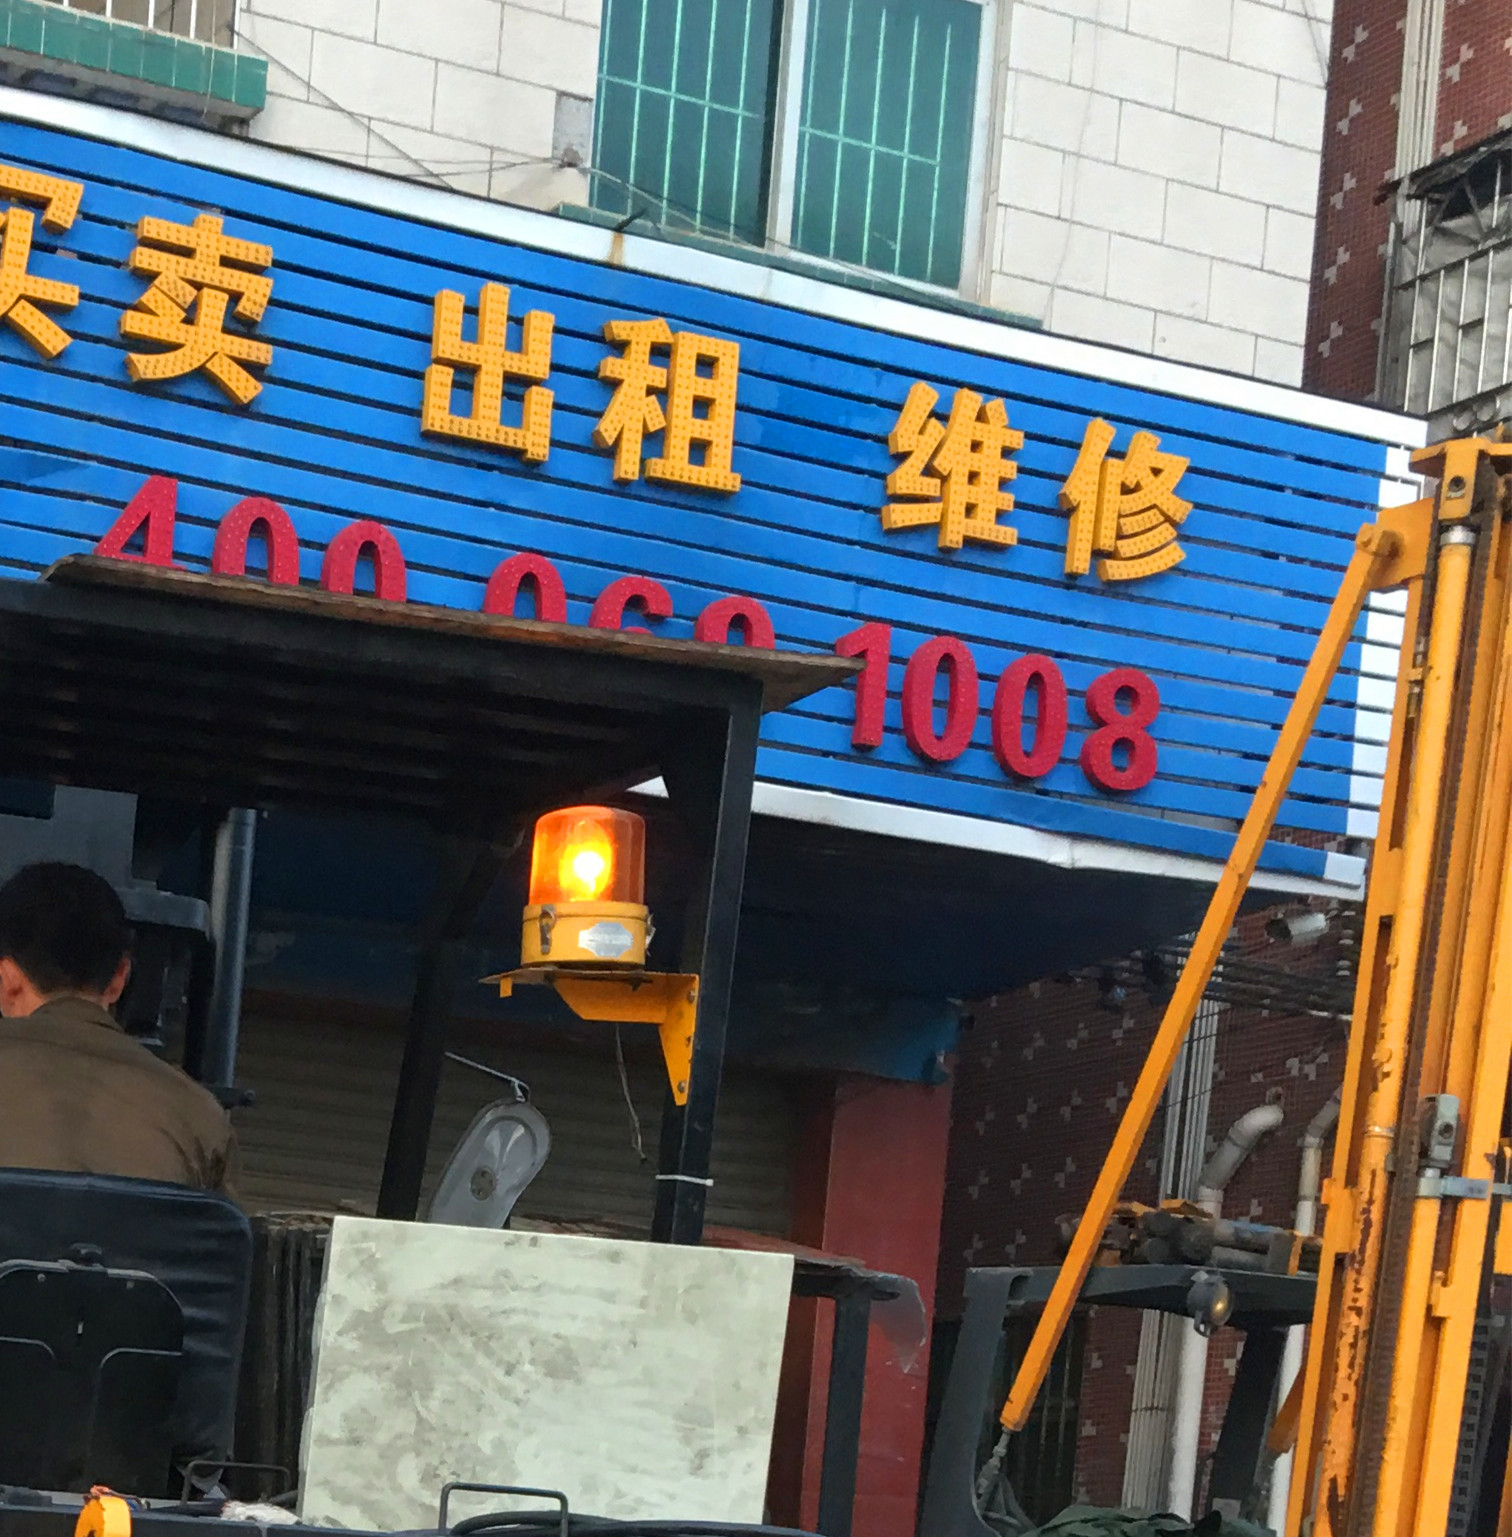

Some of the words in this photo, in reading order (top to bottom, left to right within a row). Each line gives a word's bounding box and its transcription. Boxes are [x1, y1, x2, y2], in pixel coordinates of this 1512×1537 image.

[420, 281, 742, 495] 出租
[880, 380, 1195, 582] 维修
[834, 621, 1161, 791] 1008
